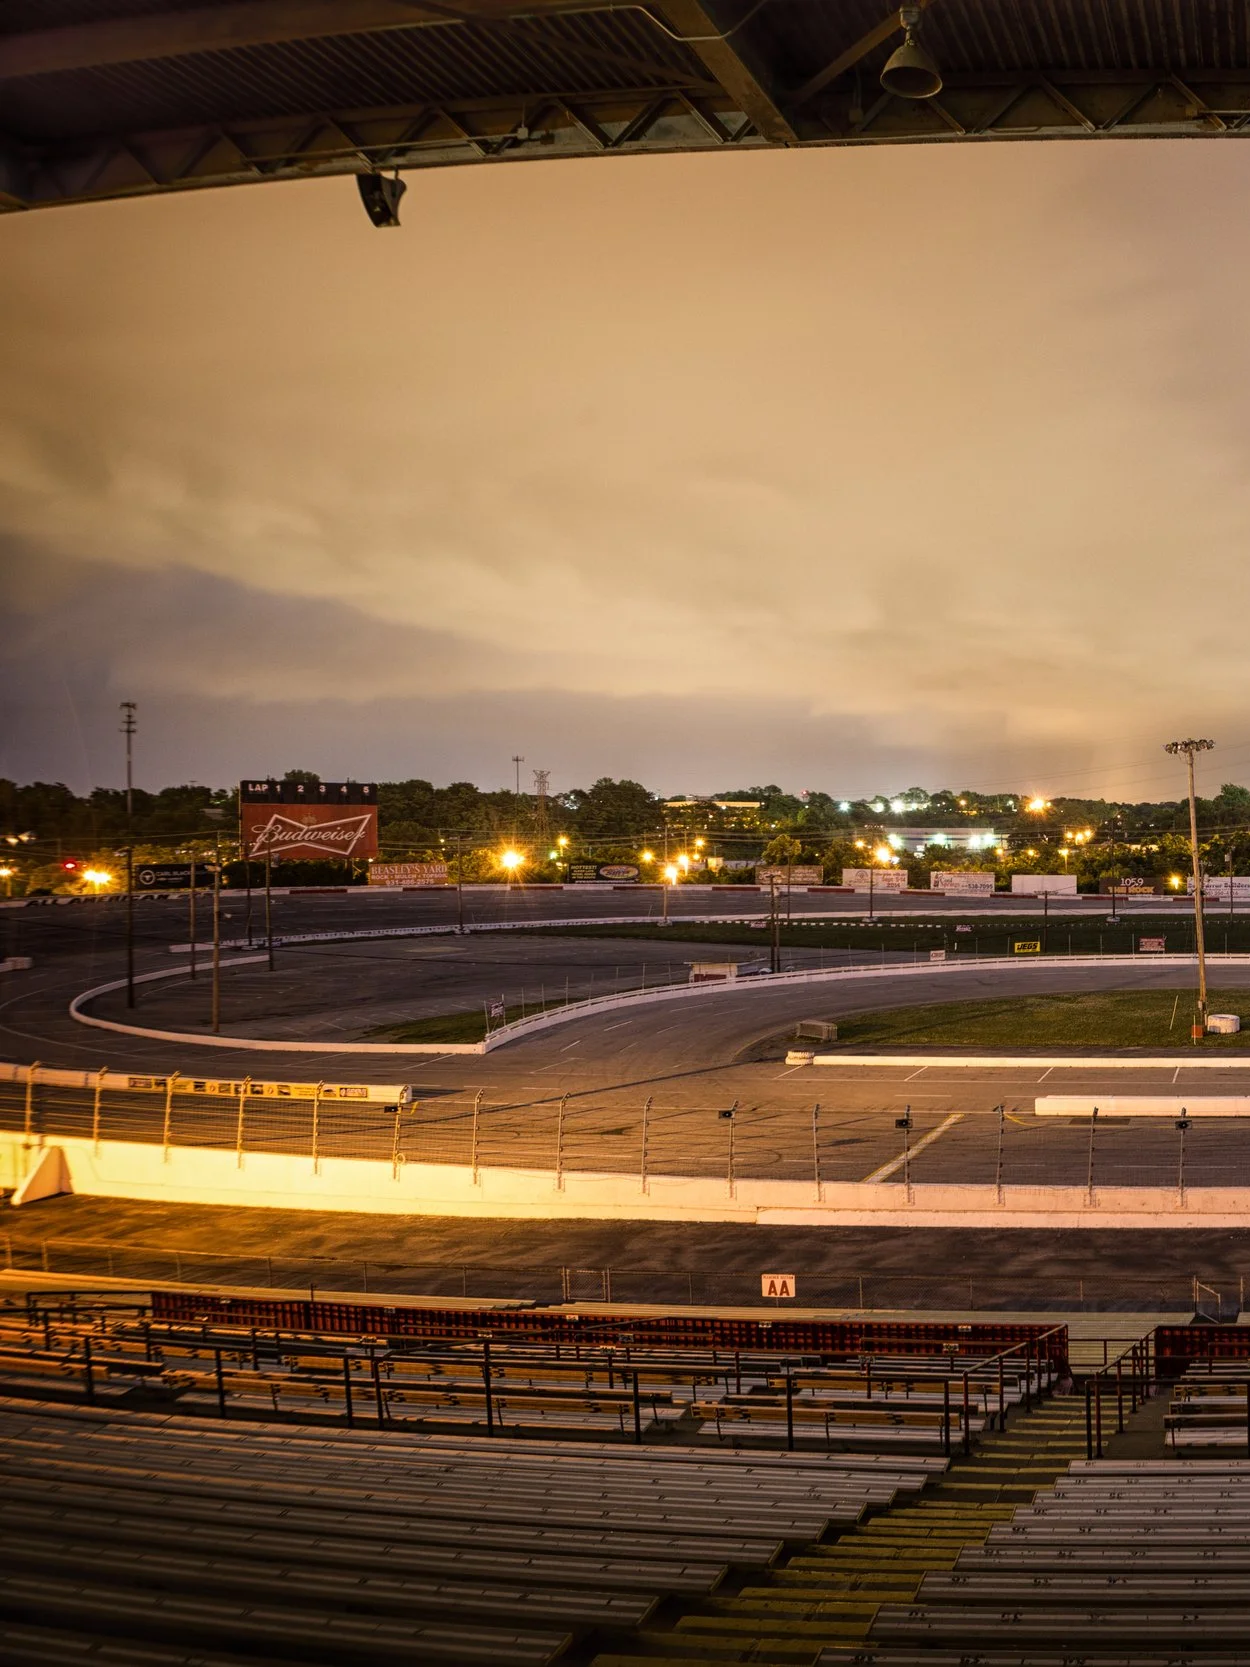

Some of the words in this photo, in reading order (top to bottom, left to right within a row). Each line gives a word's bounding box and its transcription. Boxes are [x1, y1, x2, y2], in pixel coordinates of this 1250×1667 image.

[248, 784, 268, 792] LAP
[251, 824, 366, 843] Budweiser
[371, 865, 420, 874] BEASLEY'S
[423, 865, 448, 873] YARD
[768, 1280, 790, 1296] AA
